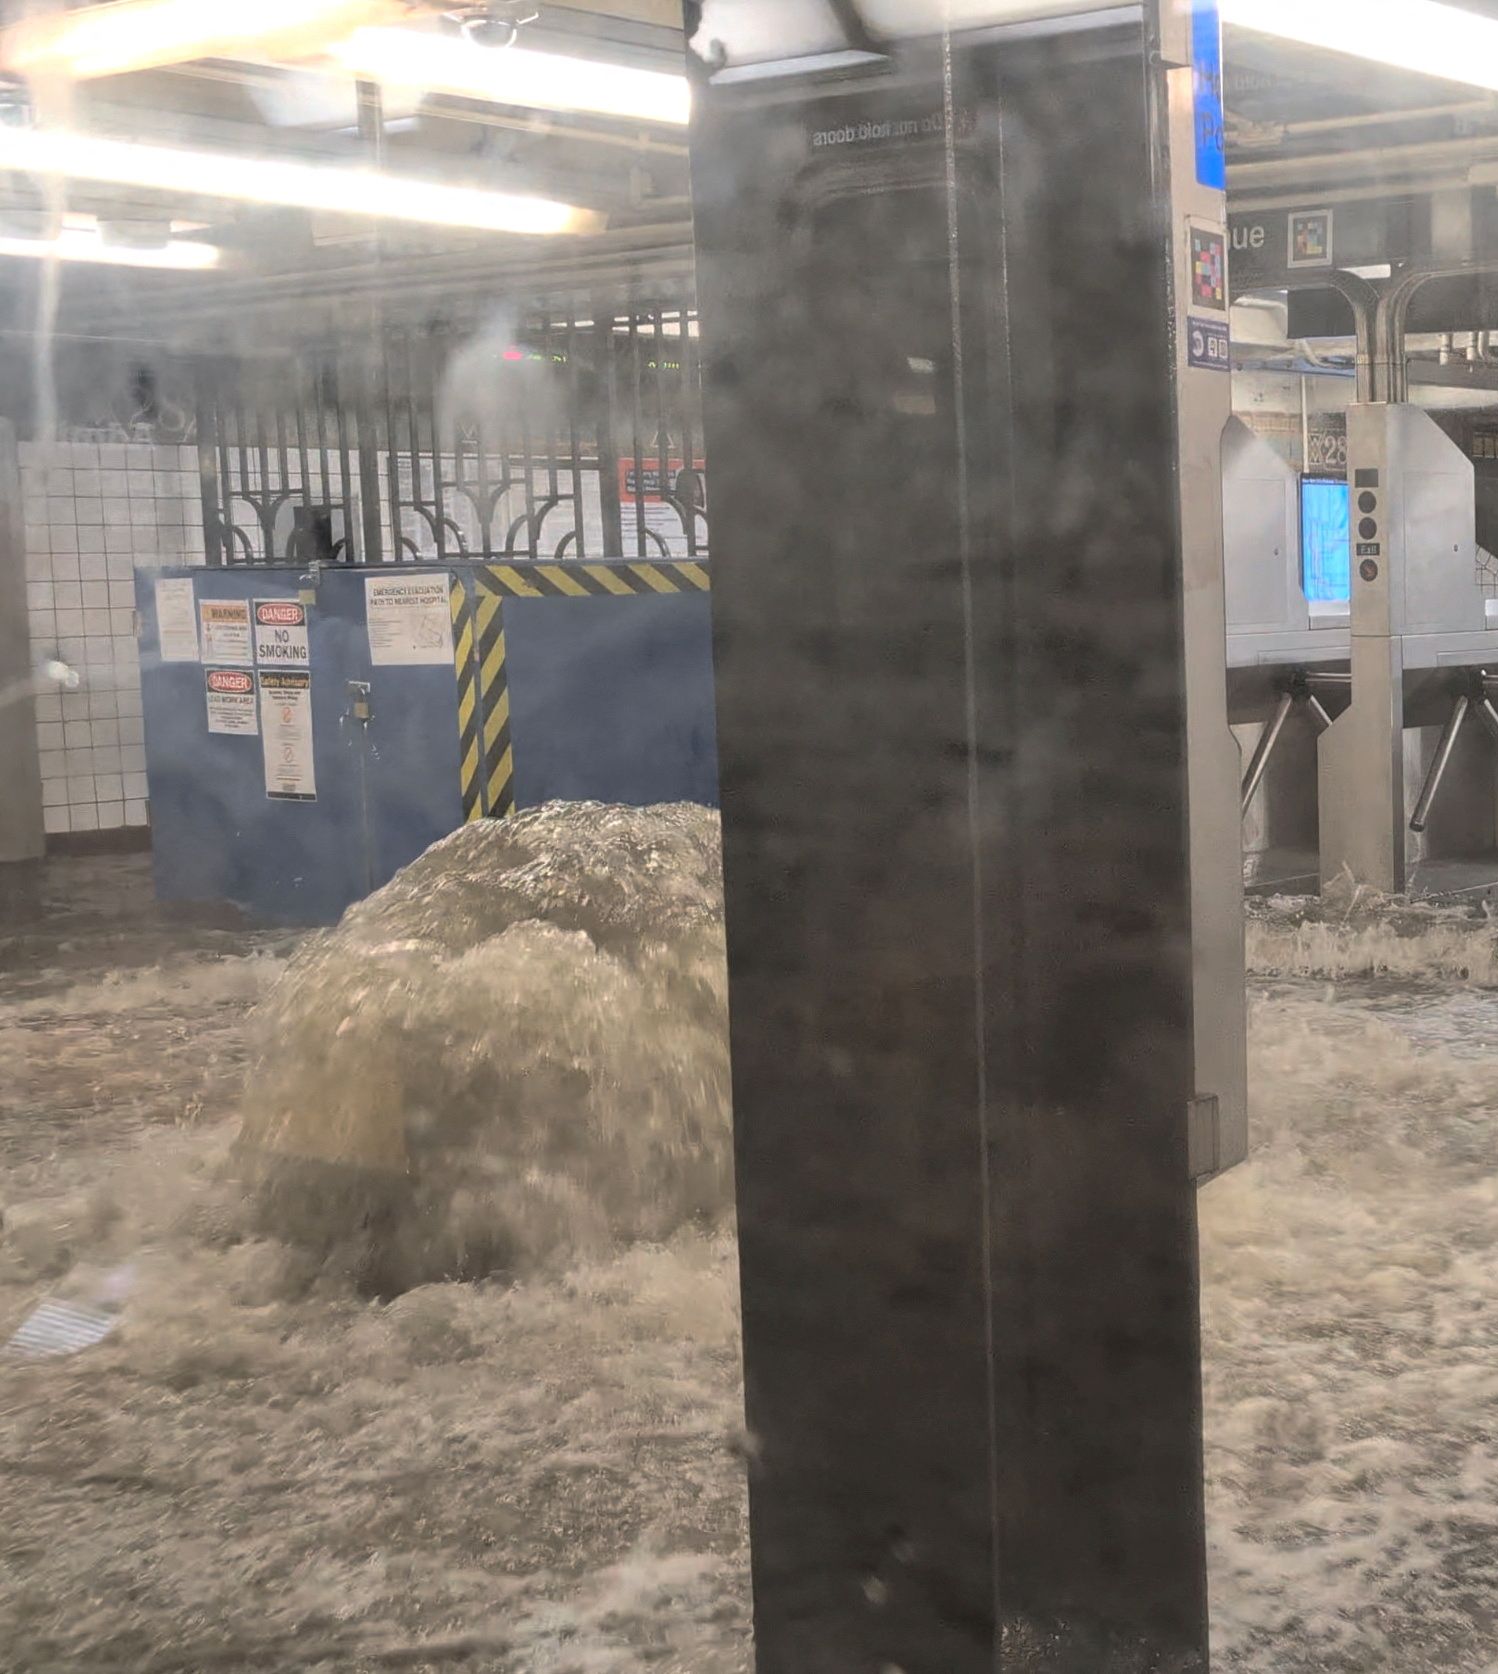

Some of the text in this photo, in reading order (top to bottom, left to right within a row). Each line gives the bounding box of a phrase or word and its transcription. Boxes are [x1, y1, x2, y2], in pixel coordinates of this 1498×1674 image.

[1227, 225, 1265, 249] ue
[1360, 544, 1377, 555] Exit
[261, 607, 298, 621] DANGER
[274, 629, 290, 644] NO
[258, 644, 307, 660] SMOKING
[211, 674, 249, 689] DANGER
